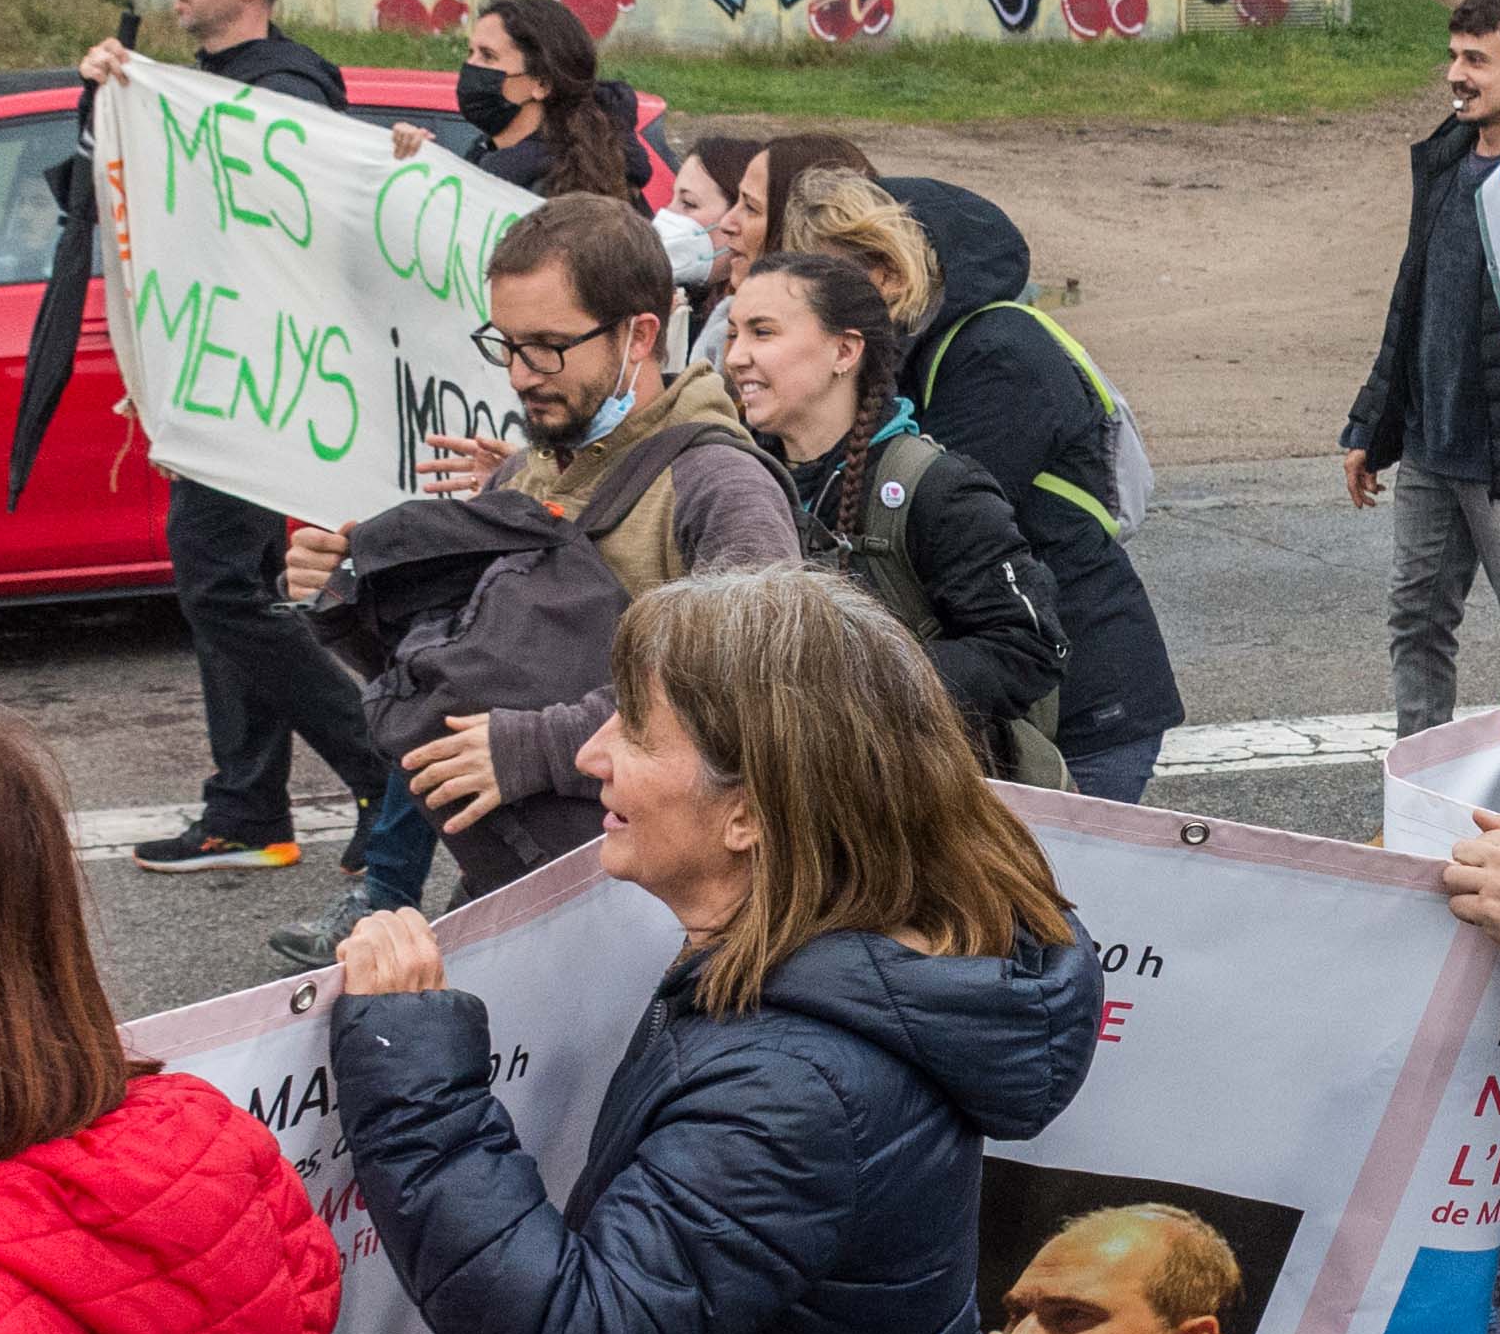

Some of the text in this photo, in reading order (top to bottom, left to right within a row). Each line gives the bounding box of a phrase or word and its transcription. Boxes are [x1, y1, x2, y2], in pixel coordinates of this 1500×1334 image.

[158, 85, 313, 249] MÉS
[136, 268, 359, 462] MENYS
[1431, 1200, 1470, 1225] de
